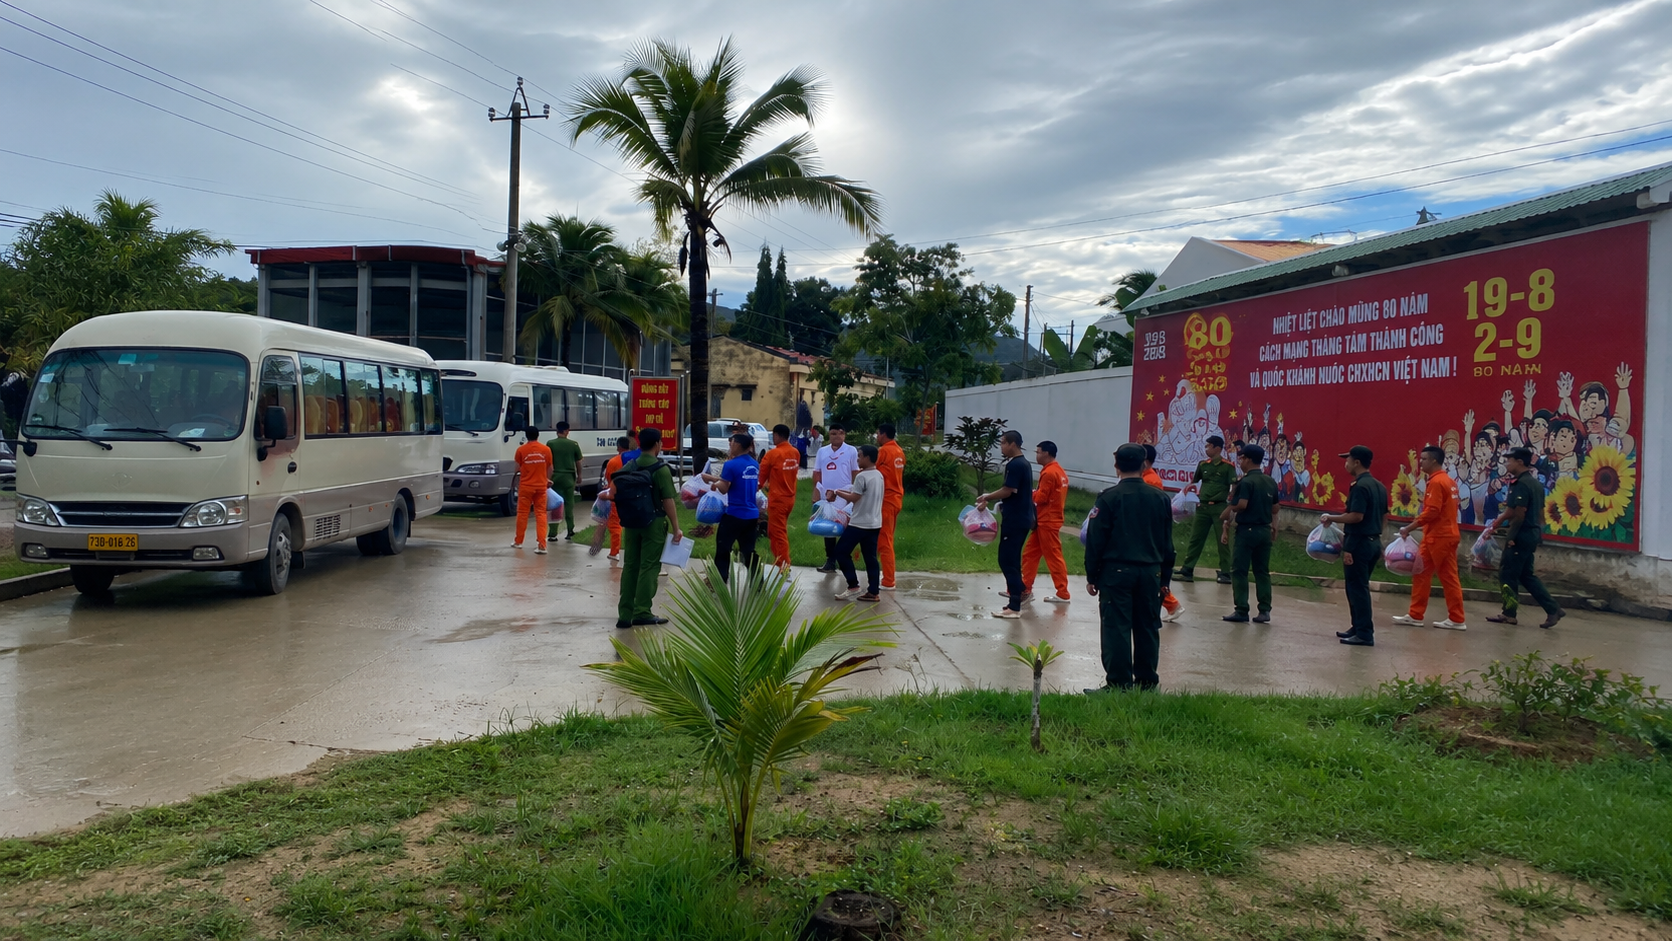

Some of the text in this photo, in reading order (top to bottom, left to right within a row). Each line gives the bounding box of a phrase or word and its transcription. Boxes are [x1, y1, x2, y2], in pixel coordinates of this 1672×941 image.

[1463, 268, 1555, 320] 19-8
[1382, 298, 1397, 319] 80
[1282, 339, 1309, 363] MẠNG
[1473, 317, 1542, 363] 2-9
[1347, 361, 1390, 383] CHXHCN
[1421, 356, 1450, 379] NAM
